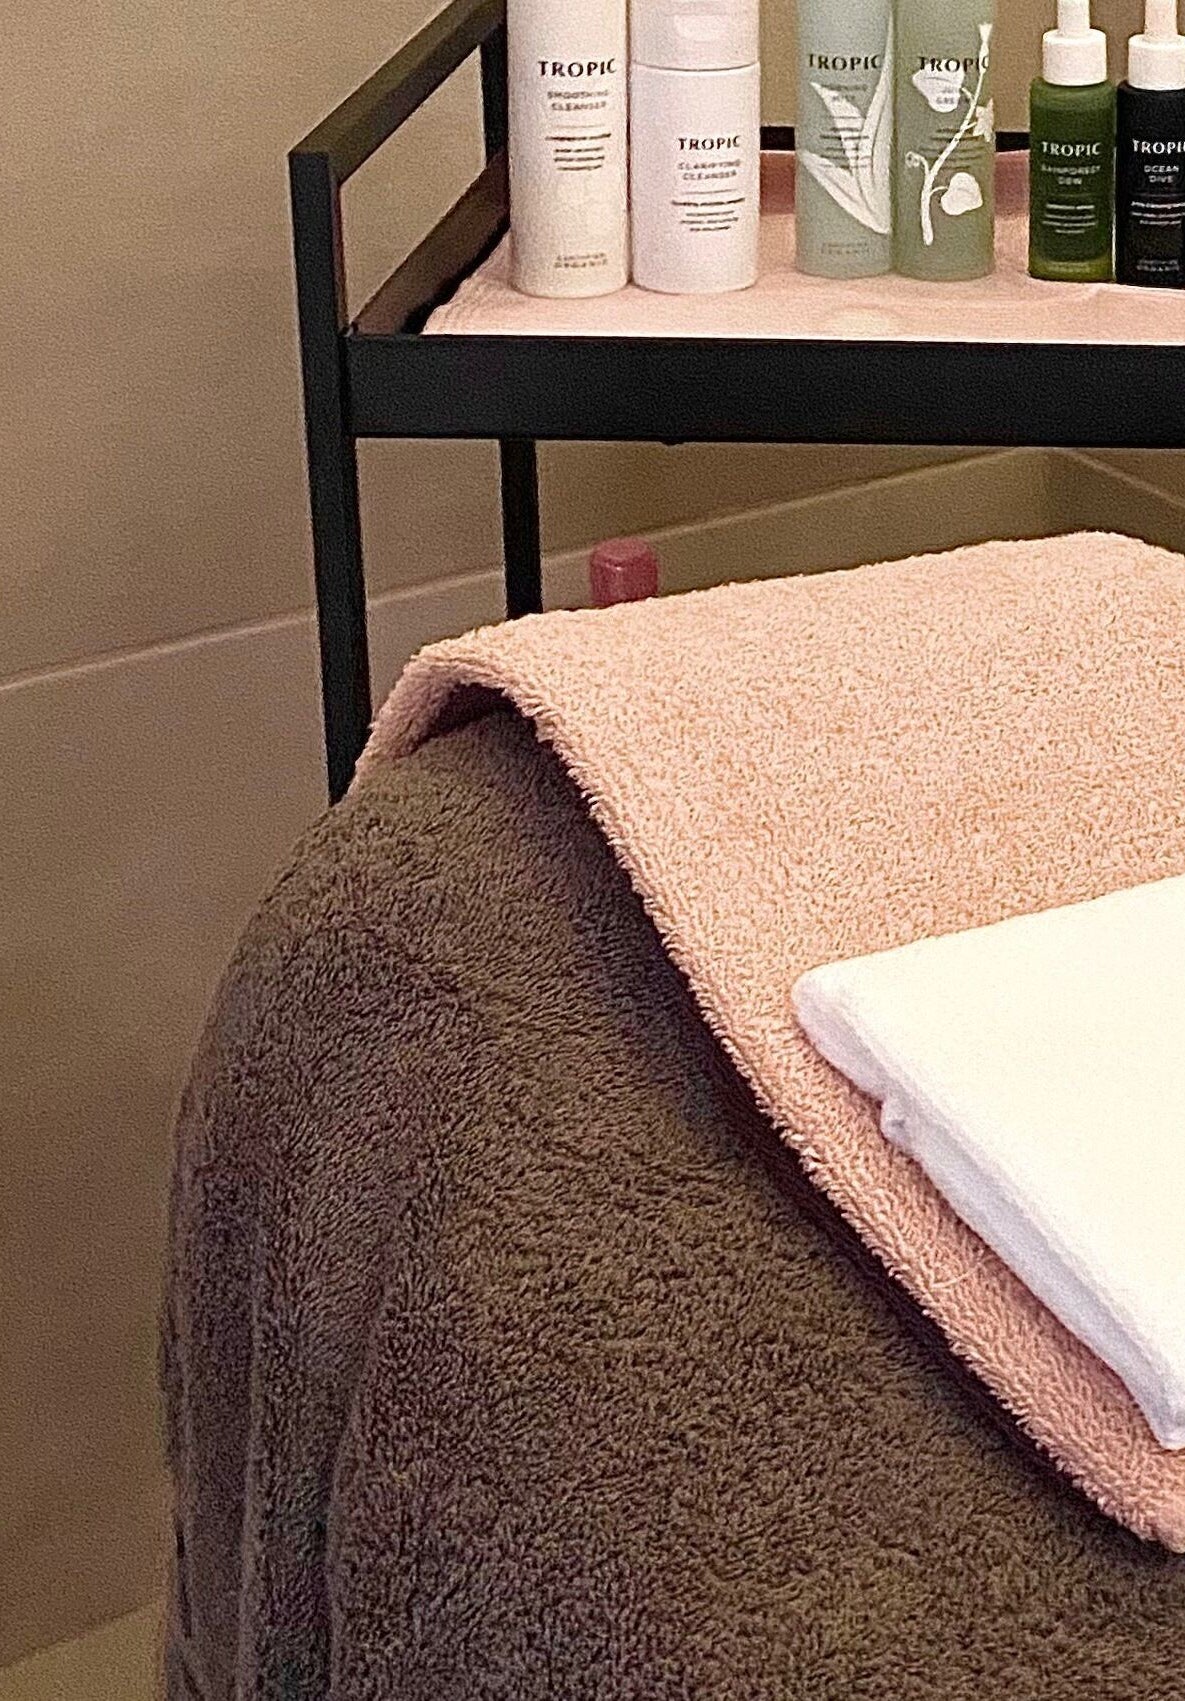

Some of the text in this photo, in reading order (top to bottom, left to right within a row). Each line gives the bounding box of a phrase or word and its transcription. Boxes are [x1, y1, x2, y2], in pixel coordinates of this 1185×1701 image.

[538, 58, 617, 78] TROPIC
[808, 53, 882, 71] TROPIC
[919, 55, 989, 73] TROPIC
[678, 135, 741, 151] TROPIC
[1041, 141, 1101, 157] TROPIC
[1144, 164, 1180, 173] OCEAN
[1148, 174, 1174, 183] DIVE
